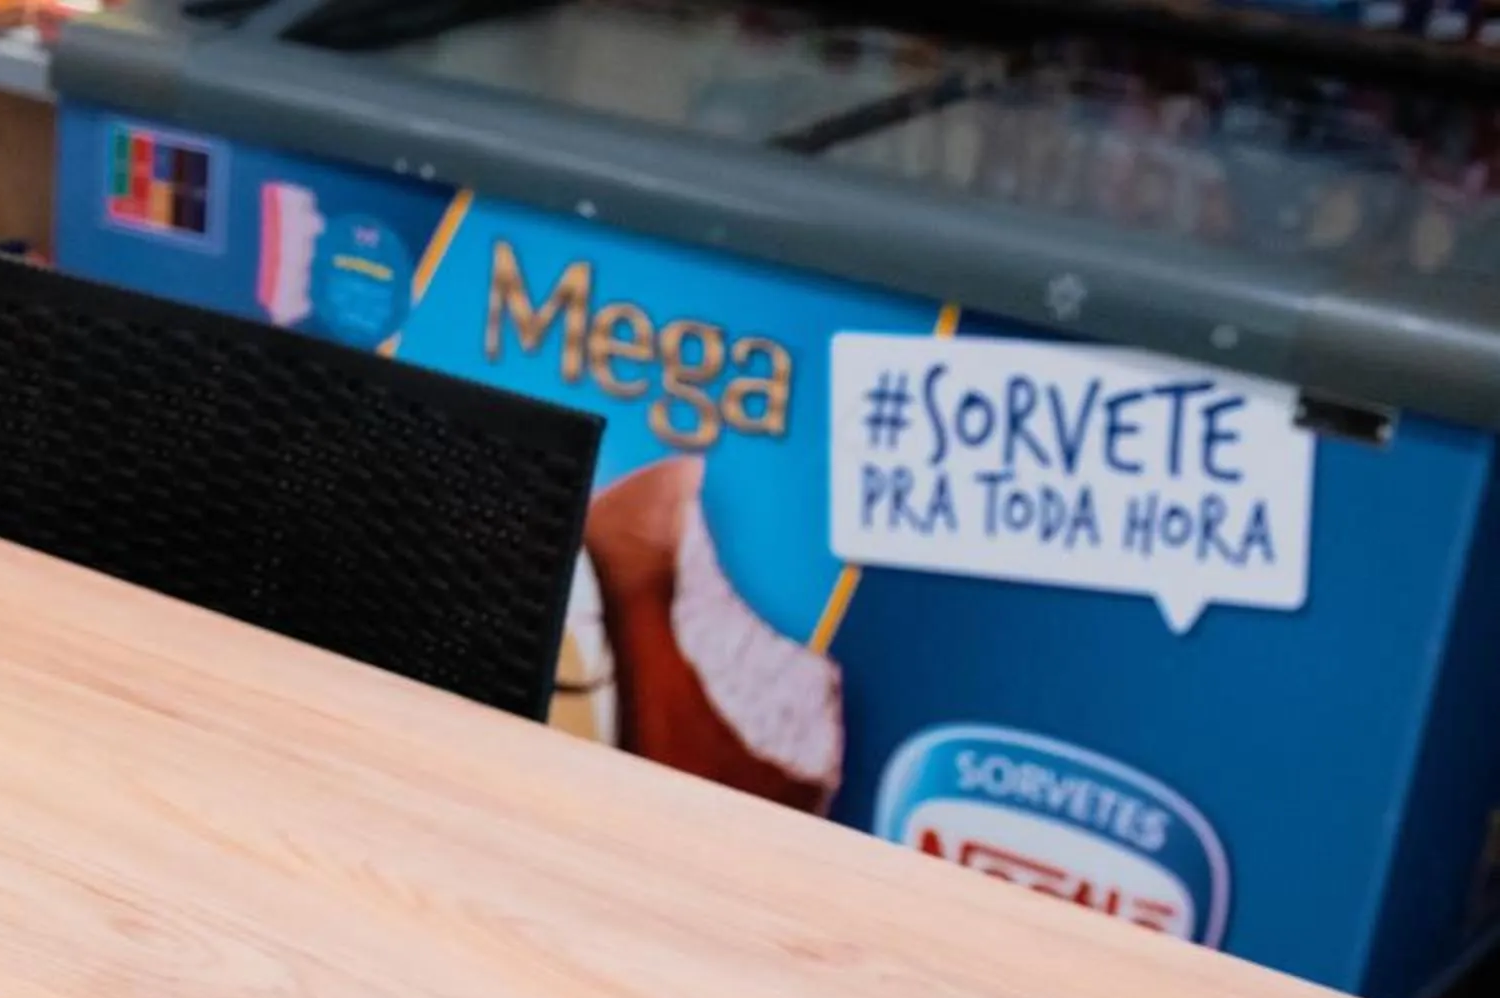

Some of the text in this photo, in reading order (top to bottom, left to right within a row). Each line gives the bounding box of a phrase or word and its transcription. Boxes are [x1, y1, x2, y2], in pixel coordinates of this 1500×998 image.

[484, 240, 792, 449] Mega
[863, 363, 1247, 482] #SORVETE
[861, 464, 1277, 567] PRA TODA HORA
[955, 749, 1172, 852] SORVETES
